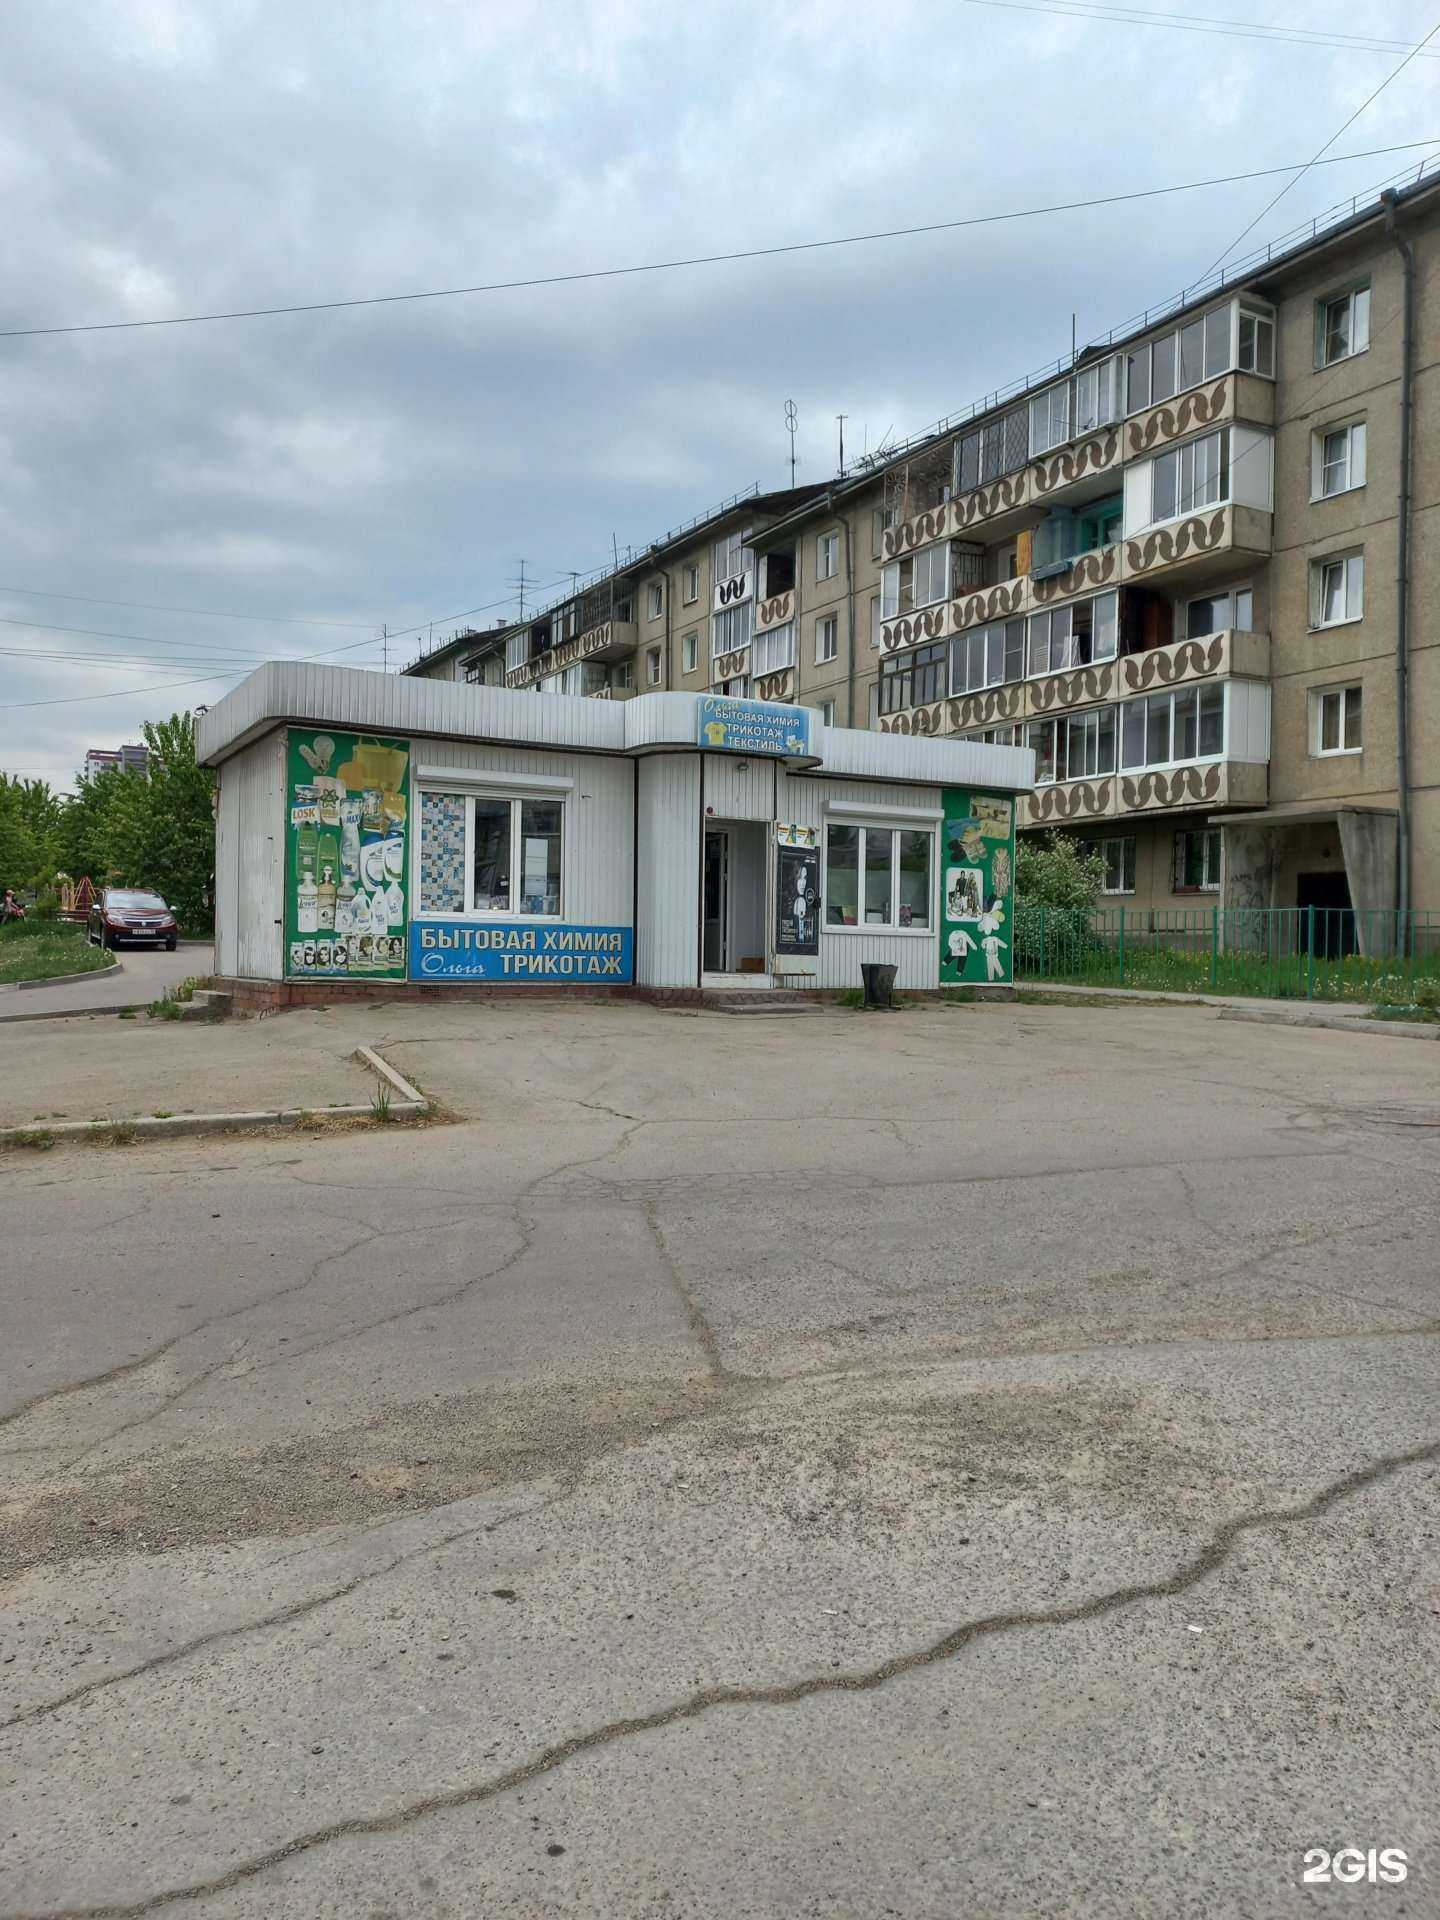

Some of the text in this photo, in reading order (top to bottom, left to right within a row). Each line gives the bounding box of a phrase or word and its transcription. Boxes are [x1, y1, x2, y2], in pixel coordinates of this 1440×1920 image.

[715, 708, 800, 728] БЫТОВАЯ ХИМИЯ
[726, 723, 784, 739] ТРИКОТАЖ
[727, 735, 783, 751] ТЕКСТИЛЬ
[293, 808, 316, 819] LOSK
[421, 928, 622, 951] БЫТОВАЯ ХИМИЯ
[499, 954, 622, 974] ТРИКОТАЖ
